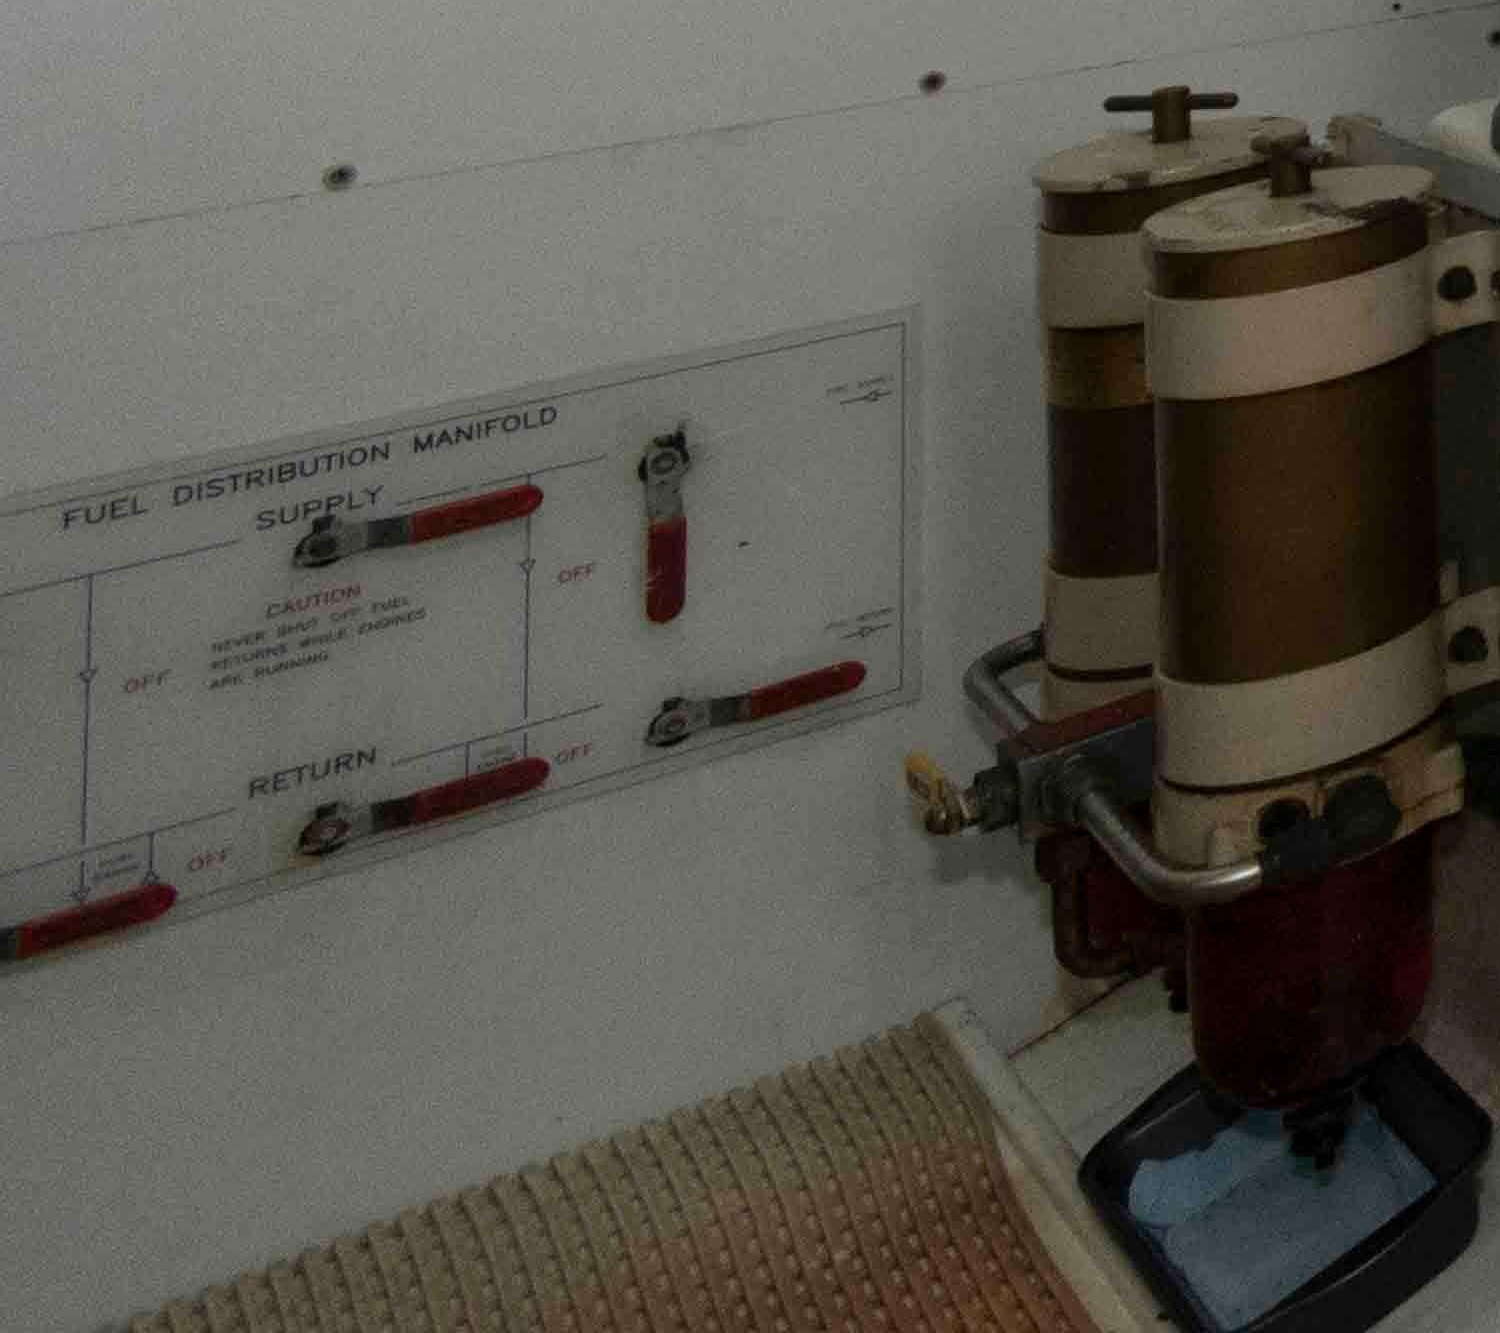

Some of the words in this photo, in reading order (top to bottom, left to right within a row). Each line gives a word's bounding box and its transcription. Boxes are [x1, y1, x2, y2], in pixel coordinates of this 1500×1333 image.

[62, 496, 149, 531] FUEL
[172, 441, 391, 509] DISTRIBUTION
[413, 405, 559, 454] MANIFOLD
[256, 485, 385, 532] SUPPLY
[557, 563, 595, 584] OFF
[266, 583, 362, 619] CAUTION
[124, 669, 170, 694] OFF
[556, 742, 594, 766] OFF
[248, 747, 377, 800] RETURN
[186, 849, 228, 873] OFF
